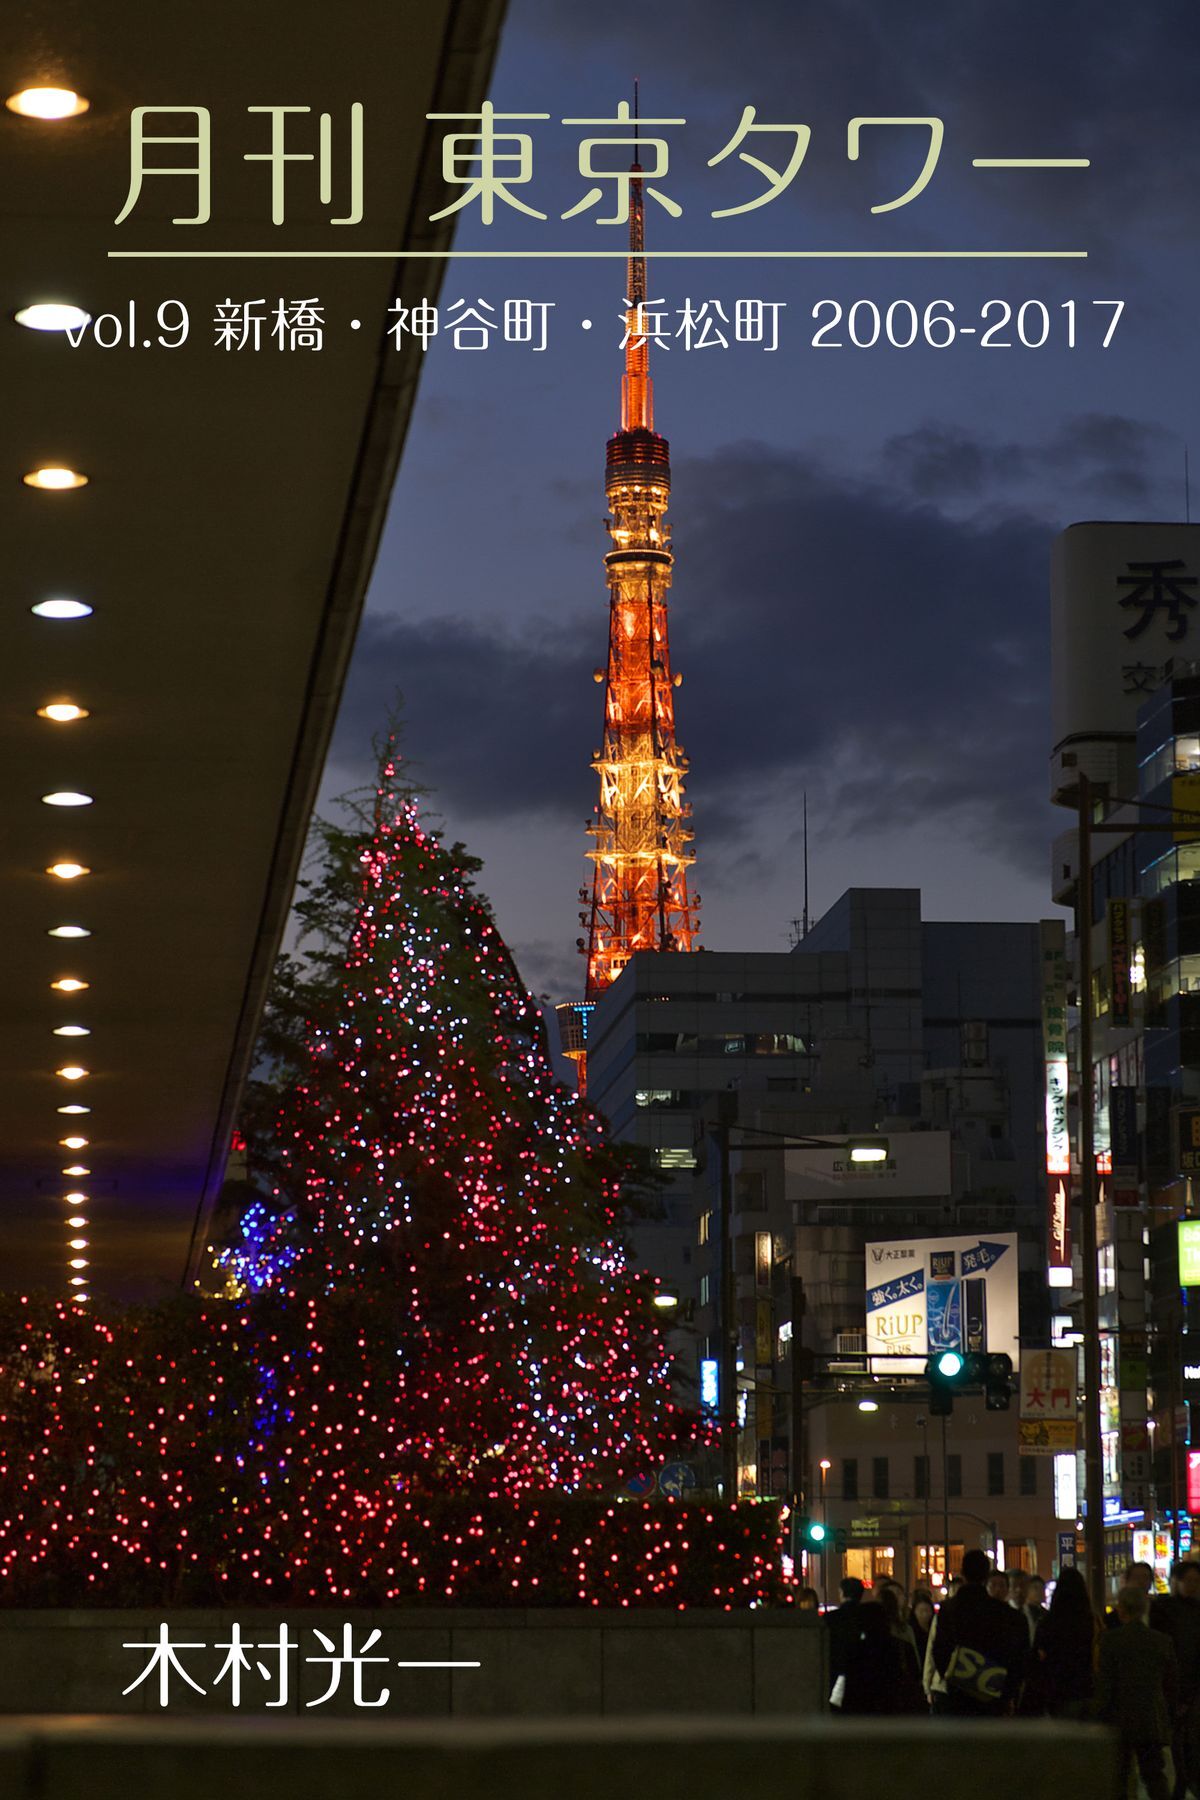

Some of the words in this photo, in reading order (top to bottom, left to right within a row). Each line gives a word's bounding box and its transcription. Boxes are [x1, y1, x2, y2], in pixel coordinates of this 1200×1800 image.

[1116, 559, 1198, 641] 秀
[875, 1314, 923, 1337] RiUP
[1026, 1387, 1070, 1409] 大門
